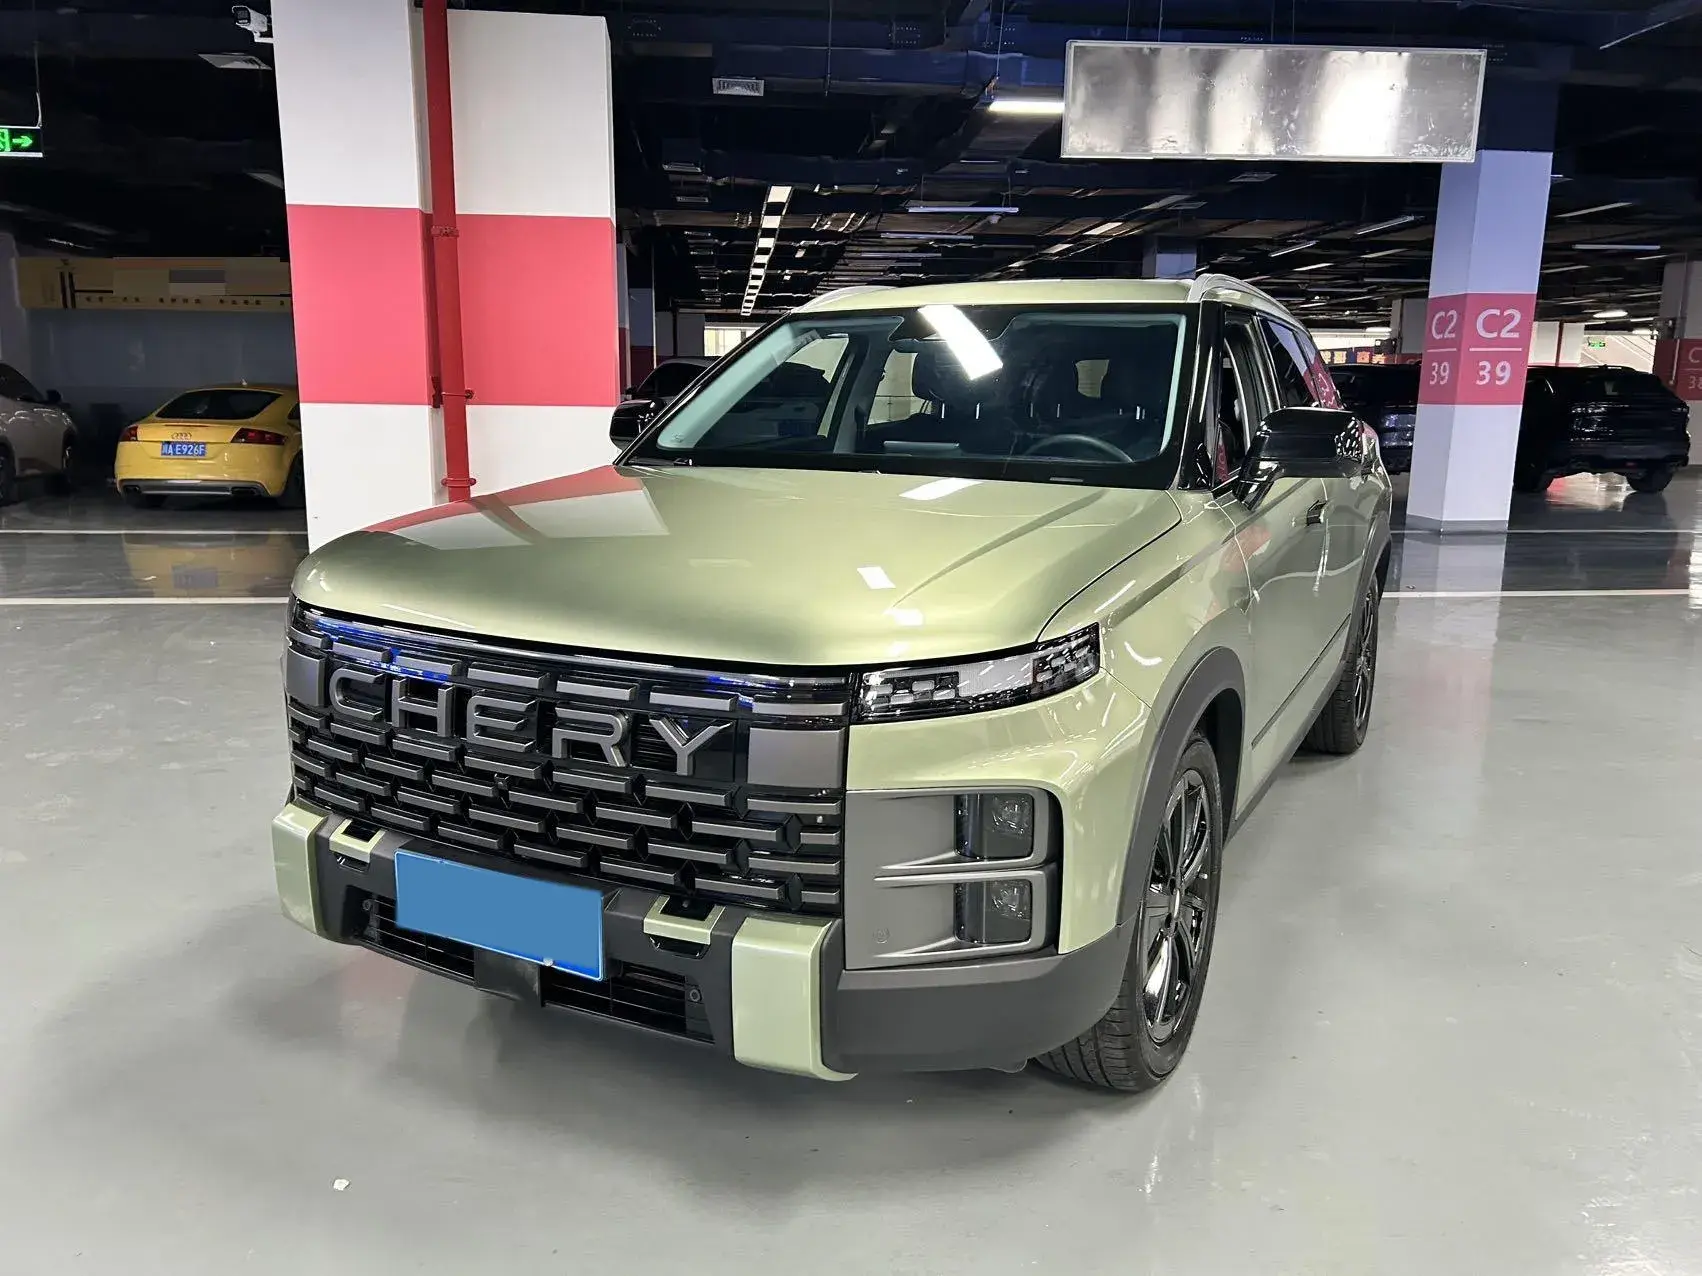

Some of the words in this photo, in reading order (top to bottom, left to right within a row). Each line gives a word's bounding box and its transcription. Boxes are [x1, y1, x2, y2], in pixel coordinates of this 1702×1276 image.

[1431, 309, 1458, 340] C2
[1476, 308, 1521, 339] C2
[1429, 361, 1450, 385] 39
[1475, 360, 1512, 386] 39
[329, 667, 734, 776] CHERY
